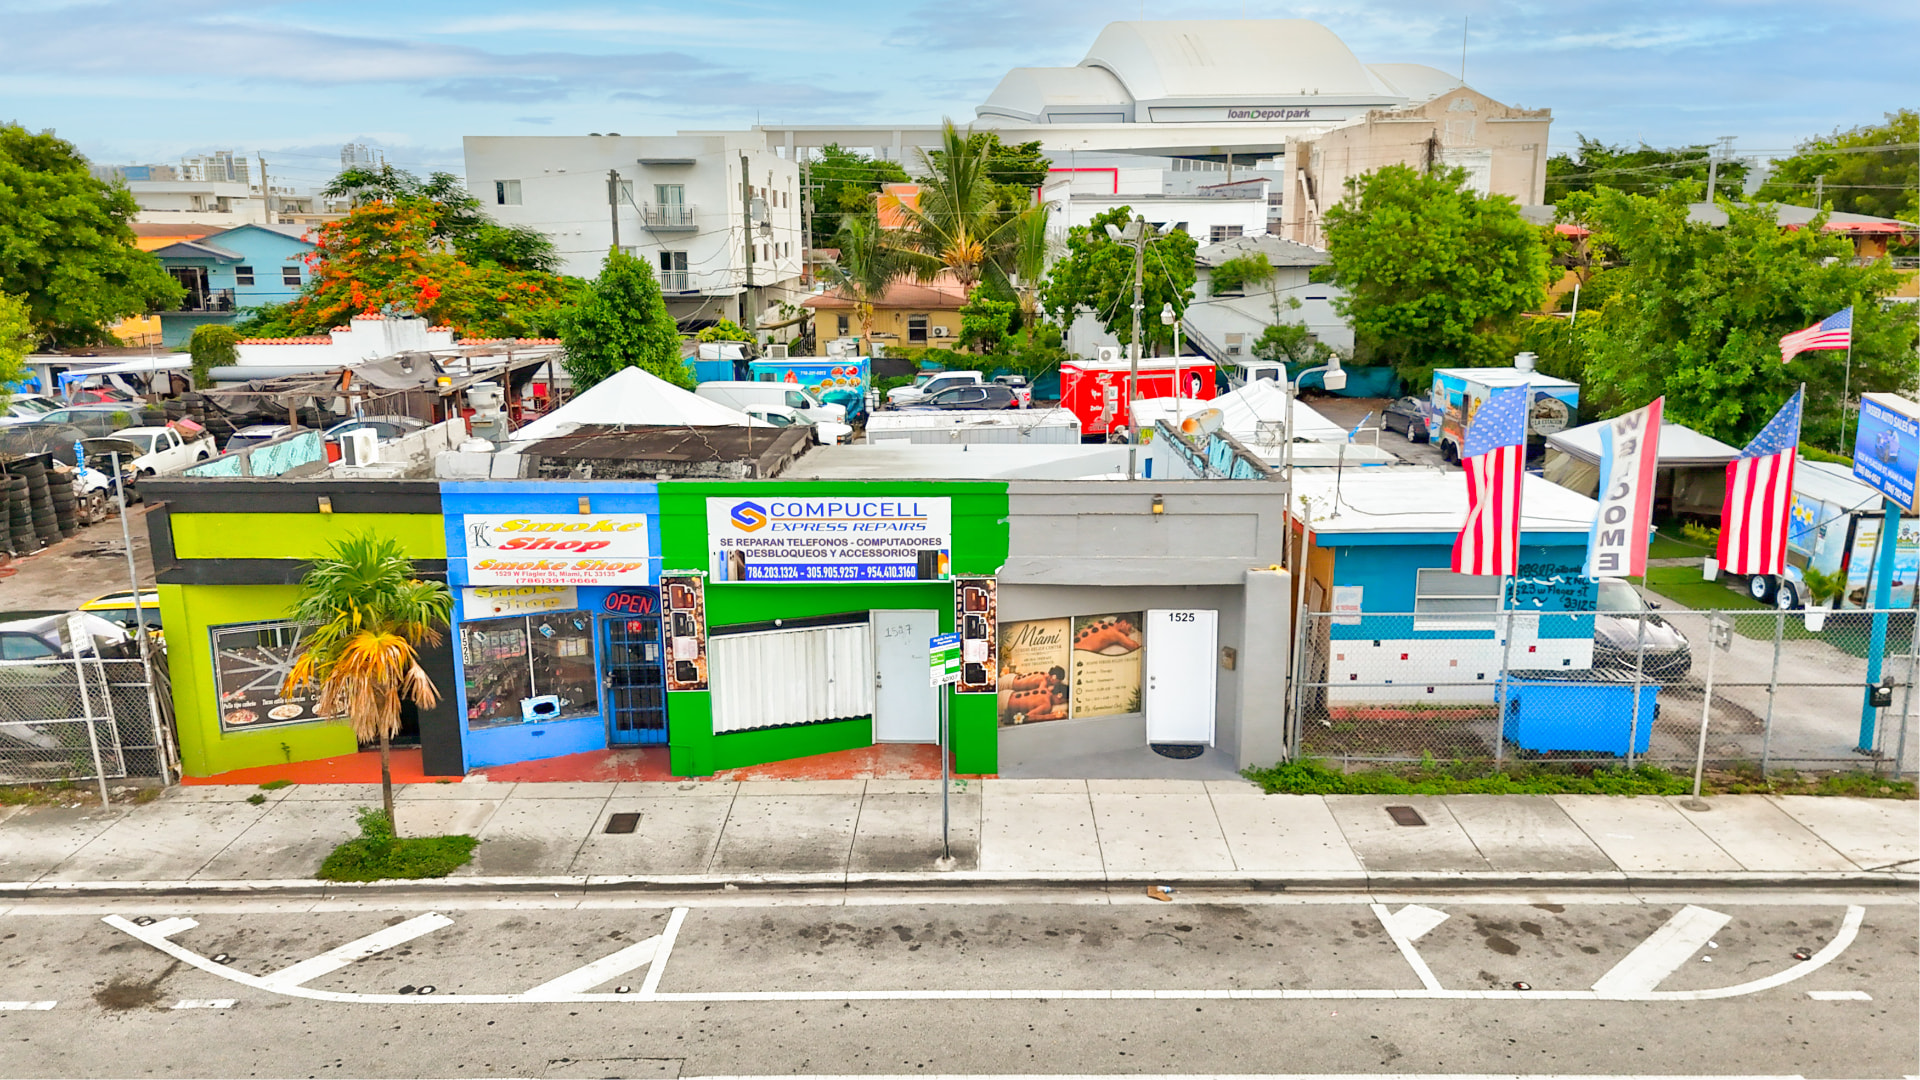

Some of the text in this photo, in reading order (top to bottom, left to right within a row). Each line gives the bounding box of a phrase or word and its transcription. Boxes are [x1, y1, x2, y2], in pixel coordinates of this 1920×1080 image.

[1227, 108, 1311, 120] loanDepot park
[770, 502, 927, 517] COMPUCELL
[493, 519, 644, 532] Smoke
[771, 522, 927, 532] EXPRESS REPAIRS
[498, 537, 611, 552] Shop
[720, 538, 733, 547] SE
[736, 538, 784, 547] REPARAN
[786, 538, 848, 547] TELEFONOS
[856, 537, 942, 546] COMPUTADORES
[746, 548, 917, 558] DESBLOQUEOS Y ACCESSORIOS
[473, 559, 642, 573] Smoke Shop
[747, 566, 799, 579] 786.203.1324
[806, 566, 859, 578] 305.905.9257
[867, 566, 916, 578] 954.410.3160
[474, 586, 568, 598] Smoke
[491, 597, 561, 611] Shop
[606, 592, 653, 614] OPEN
[1169, 613, 1195, 622] 1525
[1007, 624, 1062, 651] Miami
